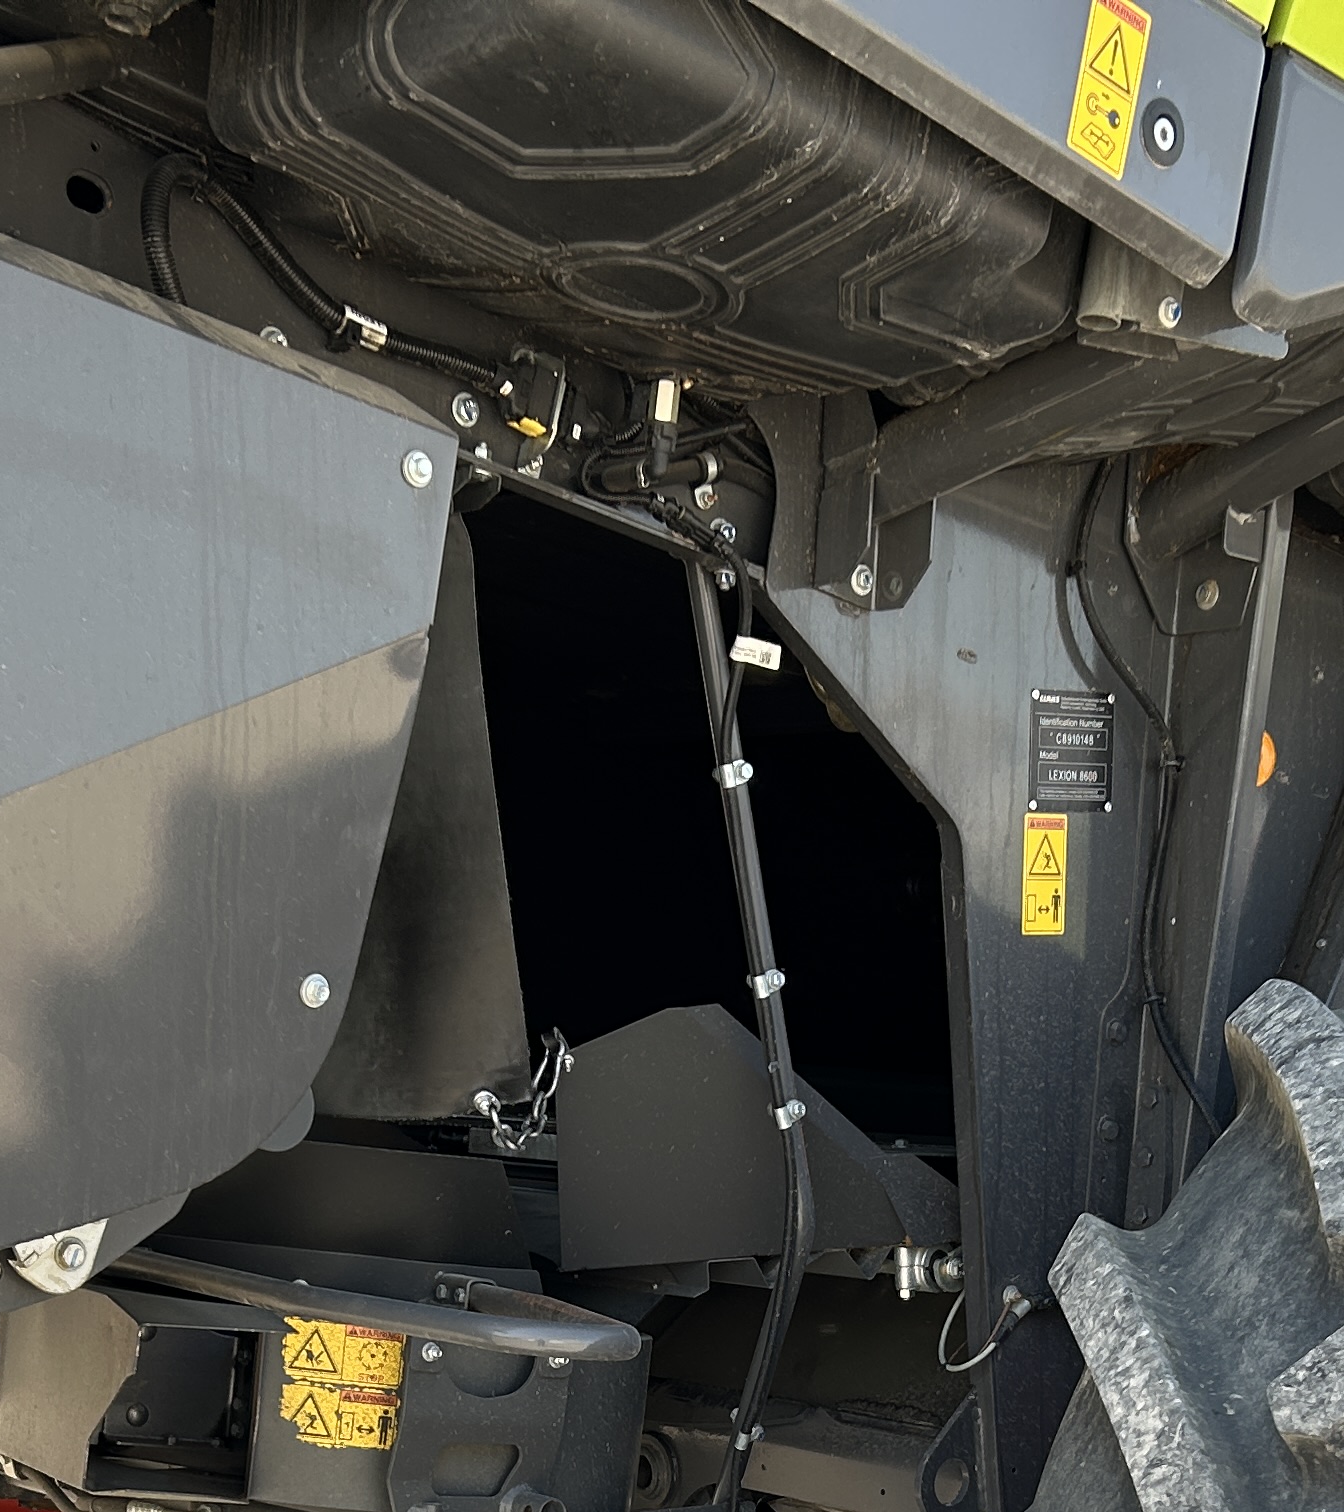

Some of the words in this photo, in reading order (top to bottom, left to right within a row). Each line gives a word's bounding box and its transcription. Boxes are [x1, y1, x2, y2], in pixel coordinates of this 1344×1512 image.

[1108, 1, 1145, 33] WARNING
[1039, 716, 1078, 727] Identification
[1079, 718, 1104, 728] Number
[1039, 750, 1059, 760] Model
[1048, 769, 1077, 781] LEXION
[359, 1329, 402, 1341] WARNING
[358, 1373, 385, 1384] STOP
[353, 1393, 395, 1406] WARNING
